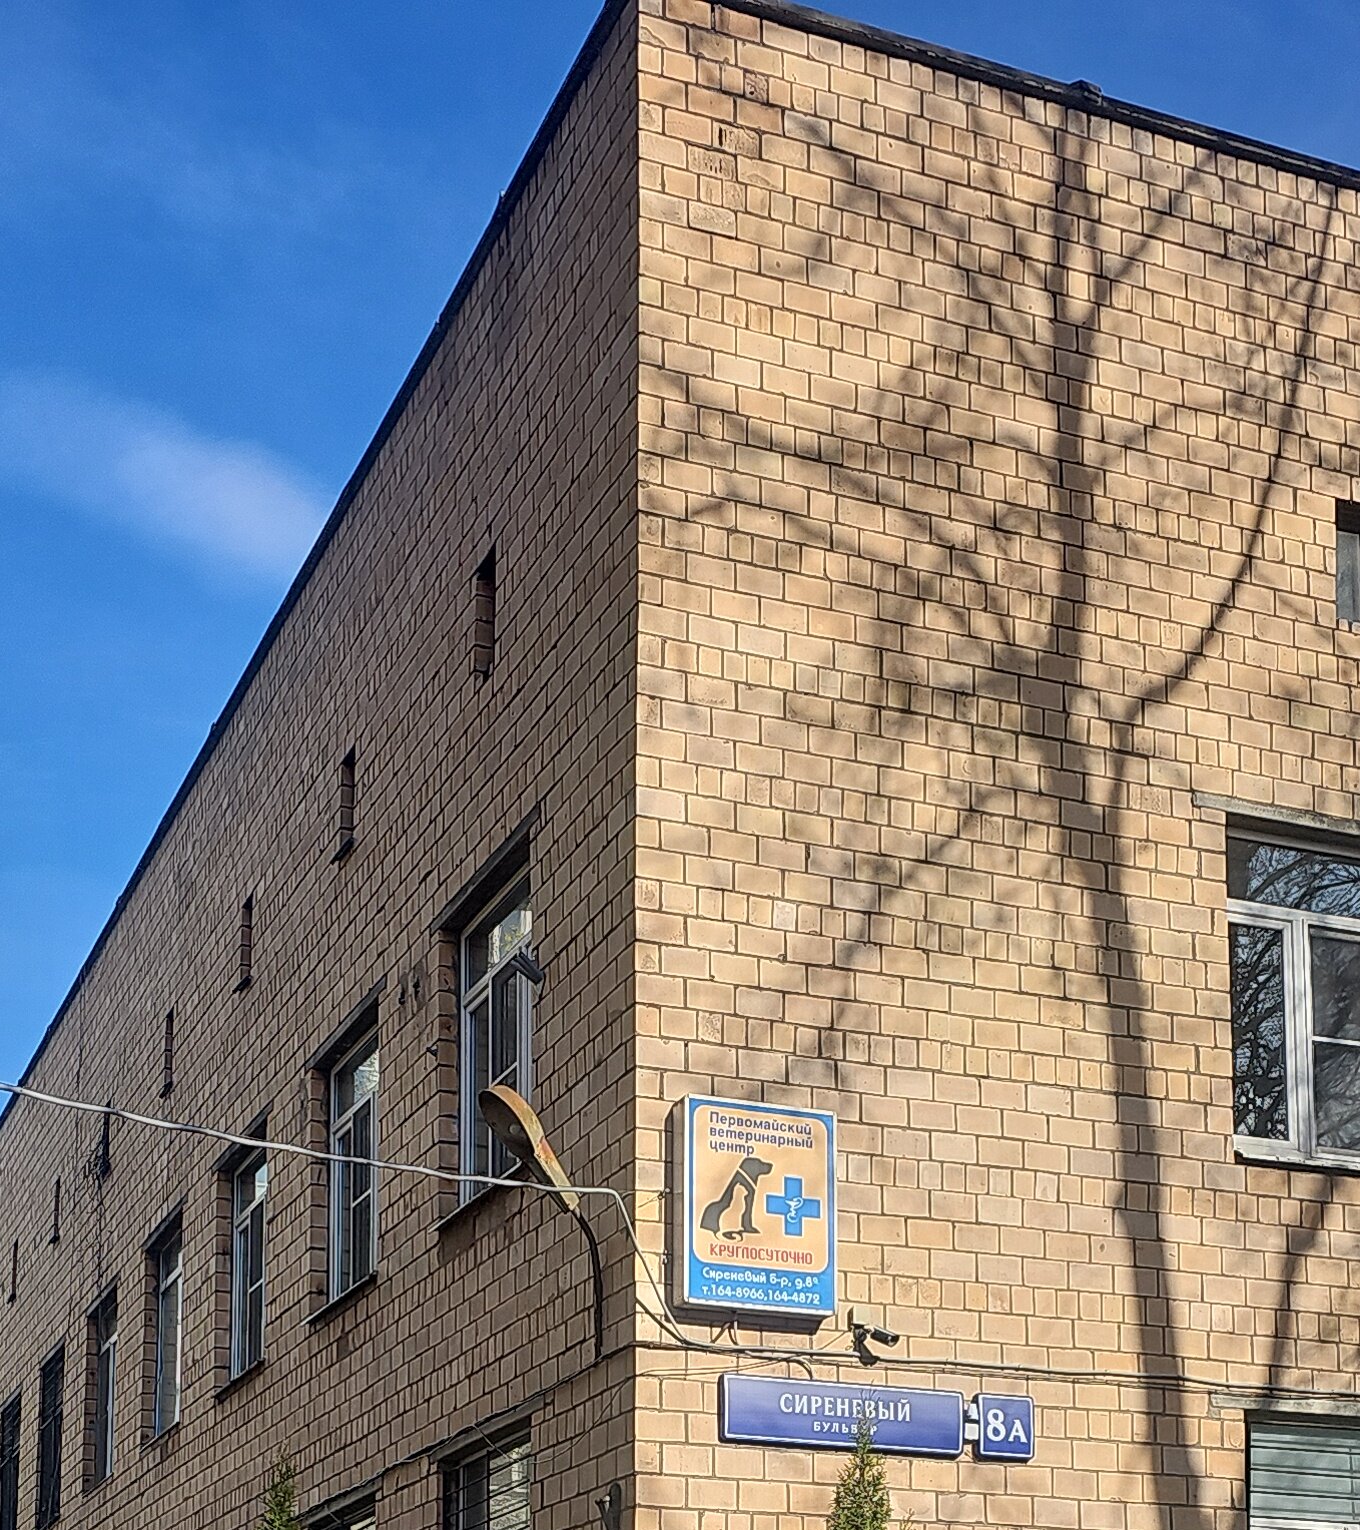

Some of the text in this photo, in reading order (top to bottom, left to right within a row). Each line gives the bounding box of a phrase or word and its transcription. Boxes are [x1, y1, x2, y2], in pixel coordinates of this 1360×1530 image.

[709, 1110, 813, 1136] Первомайский
[709, 1126, 814, 1149] ветеринарный
[709, 1139, 755, 1156] центр
[709, 1243, 813, 1265] КРУГЛОСУТОЧНО
[702, 1266, 767, 1284] Сиреневый
[779, 1392, 912, 1422] СИРЕНЕВЫЙ
[813, 1420, 878, 1436] БУЛЬВР
[985, 1408, 1029, 1444] 8А
